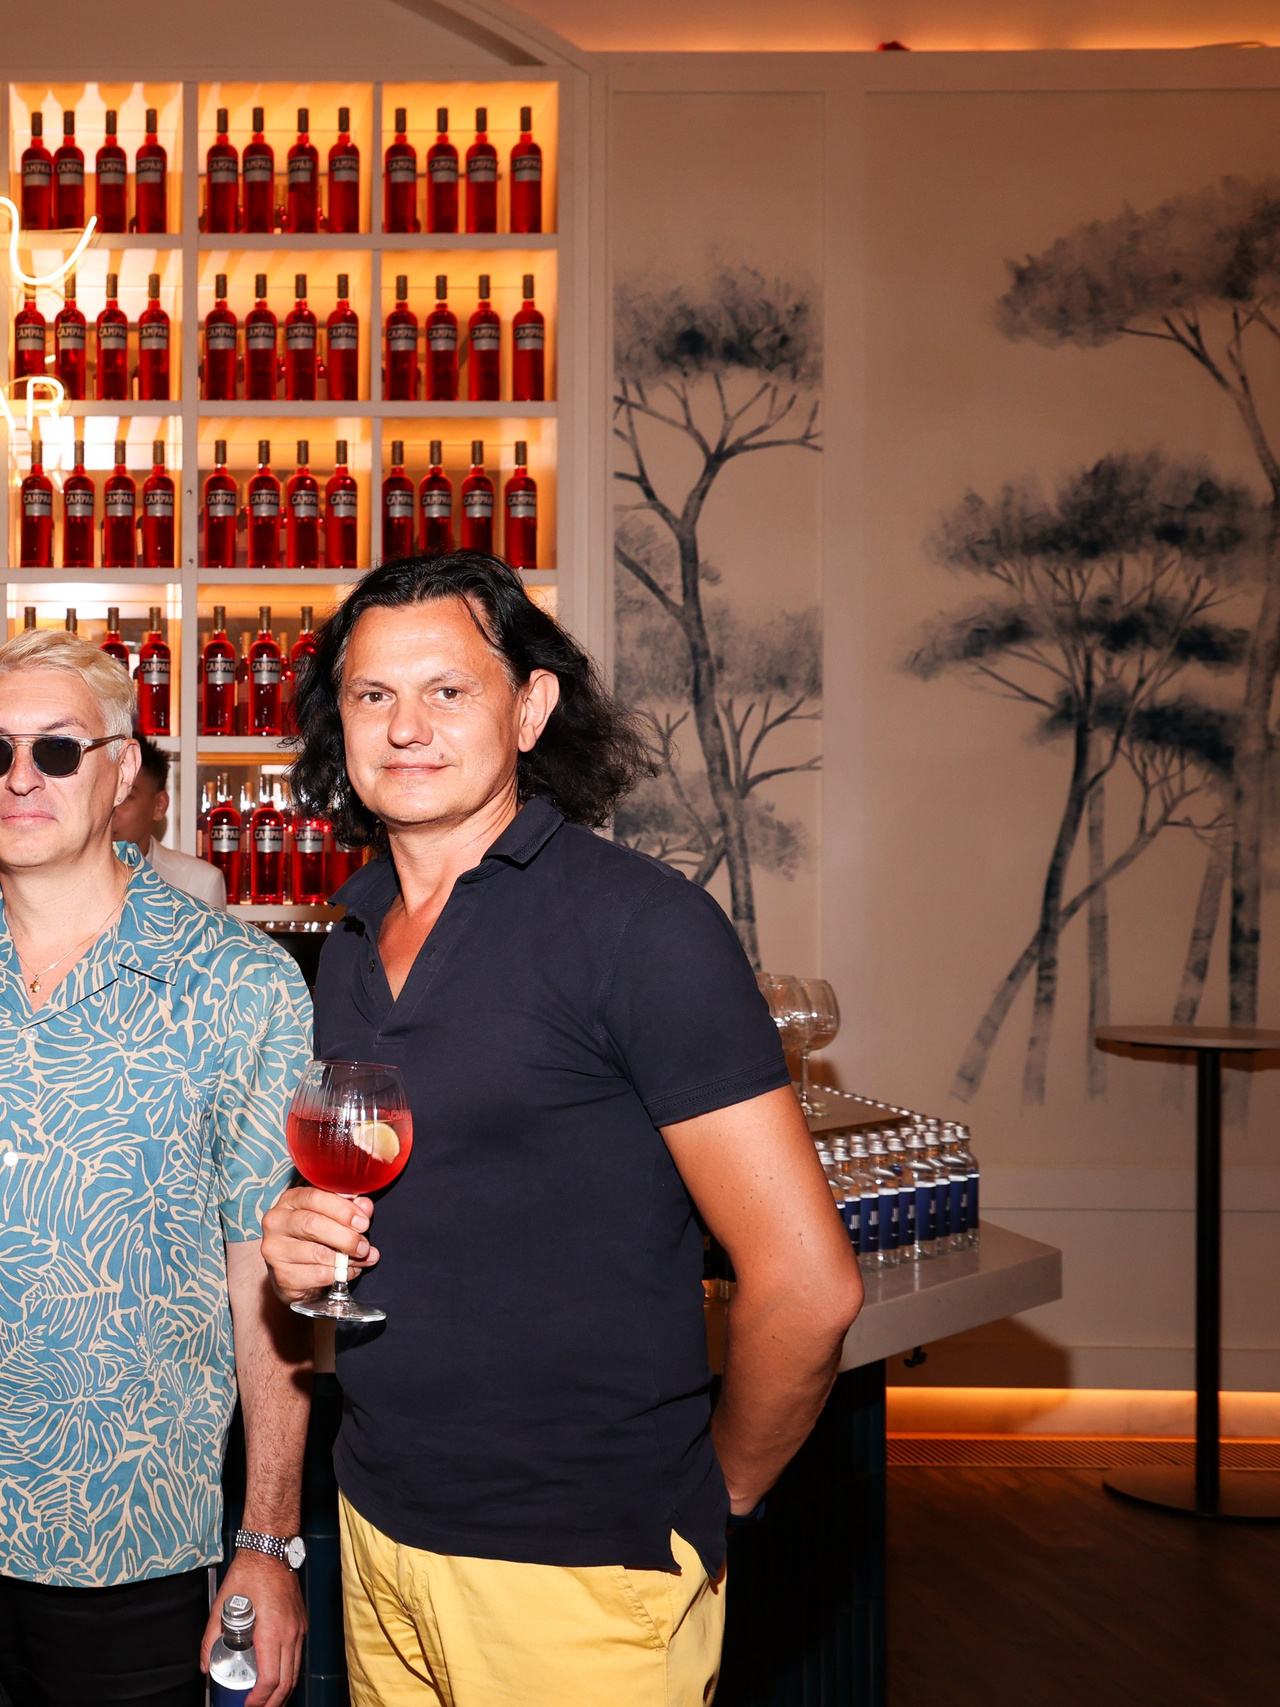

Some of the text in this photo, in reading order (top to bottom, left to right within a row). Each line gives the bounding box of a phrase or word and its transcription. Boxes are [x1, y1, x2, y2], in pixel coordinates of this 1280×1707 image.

[211, 829, 239, 840] CAMPAR
[255, 829, 282, 840] CAMPAR
[296, 829, 324, 840] CAMPAR
